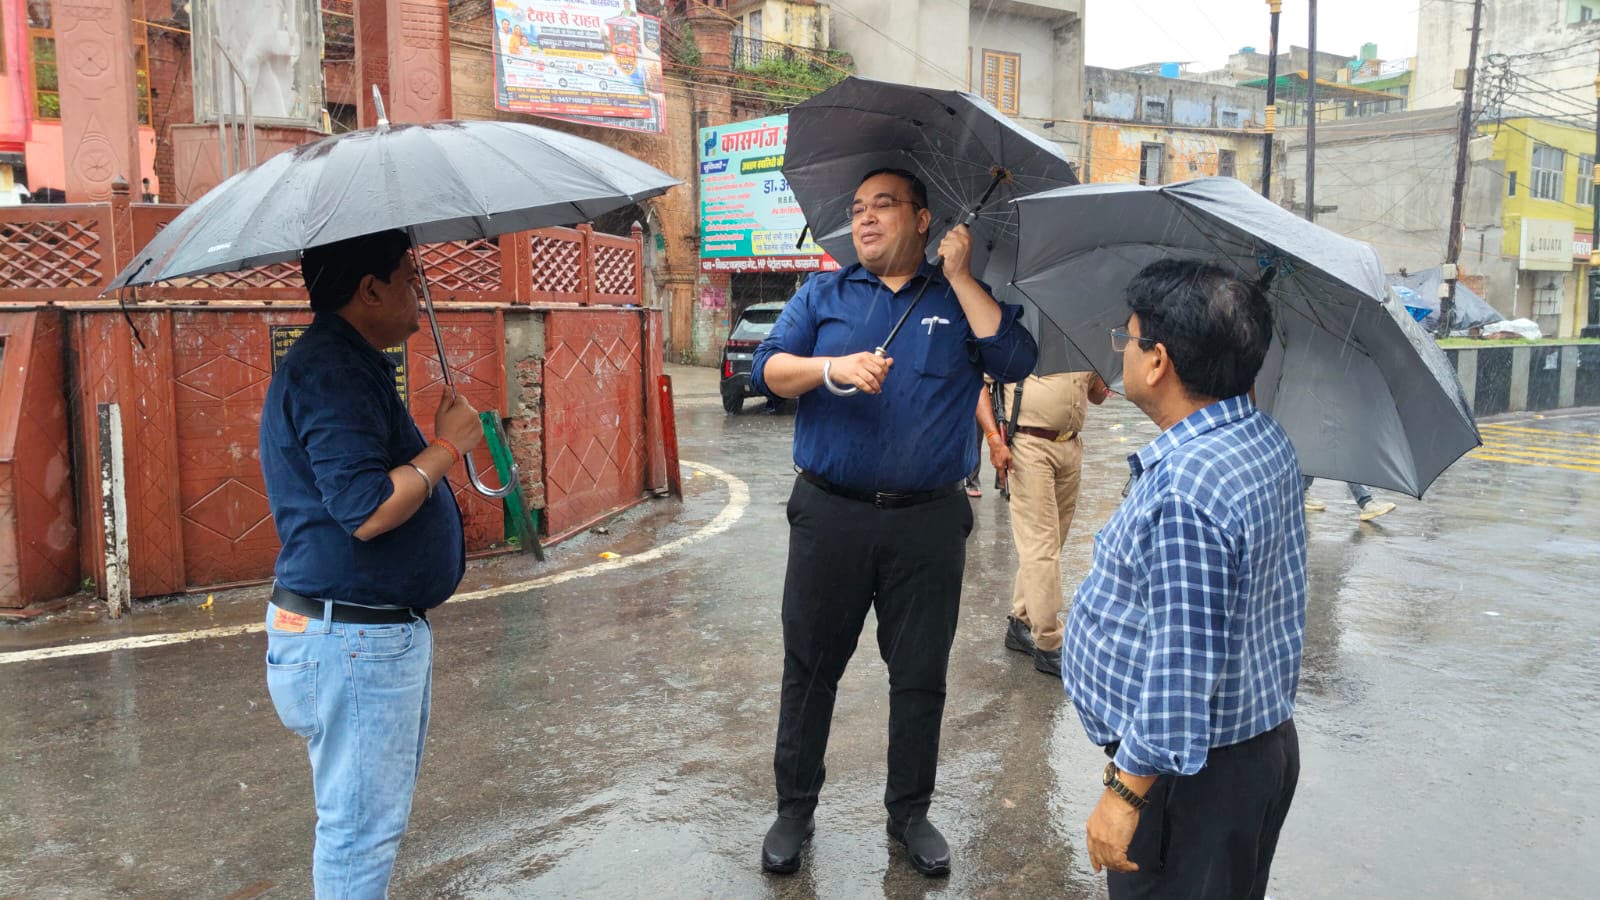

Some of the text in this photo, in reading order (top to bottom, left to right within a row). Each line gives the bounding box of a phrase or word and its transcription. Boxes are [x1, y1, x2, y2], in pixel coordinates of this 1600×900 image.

[527, 7, 601, 28] टैक्स से राहत
[721, 123, 780, 153] कासगंज
[1539, 238, 1562, 252] SUJATA
